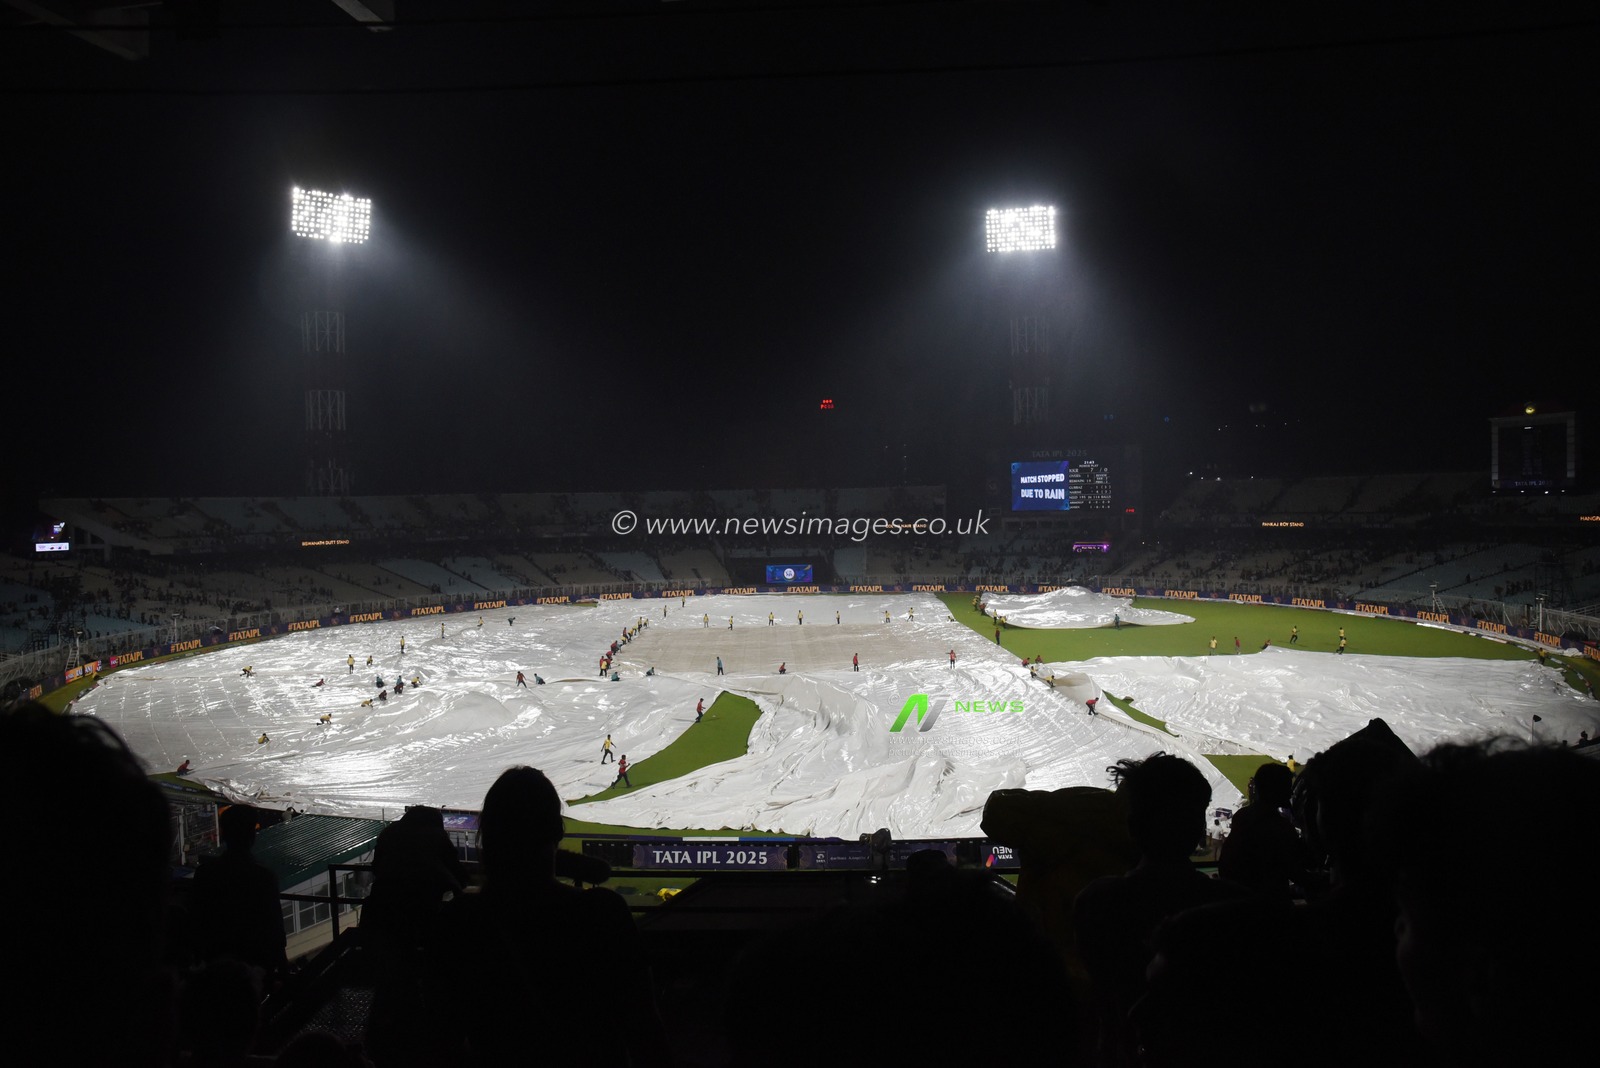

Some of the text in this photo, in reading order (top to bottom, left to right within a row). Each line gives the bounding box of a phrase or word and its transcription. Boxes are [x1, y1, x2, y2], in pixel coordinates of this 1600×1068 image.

[1020, 473, 1065, 484] MATCH STOPPED
[1020, 488, 1065, 500] DUE TO RAIN
[662, 589, 695, 598] #TATAIPL
[912, 584, 946, 592] #TATAIPL
[976, 584, 1010, 592] #TATAIPL
[1165, 589, 1200, 598] #TATAIPL
[537, 596, 571, 604] #TATAIPL
[600, 592, 633, 600] #TATAIPL
[1229, 593, 1264, 604] #TATAIPL
[474, 600, 508, 610] #TATAIPL
[1292, 598, 1326, 608] #TATAIPL
[1355, 602, 1390, 615] #TATAIPL
[412, 605, 446, 616] #TATAIPL
[350, 612, 384, 623] #TATAIPL
[1417, 610, 1450, 623] #TATAIPL
[288, 619, 321, 631] #TATAIPL
[1477, 619, 1508, 635] #TATAIPL
[229, 628, 262, 642] #TATAIPL
[1534, 631, 1561, 647] #TATAIPL
[170, 639, 203, 654] #TATAIPL
[992, 846, 1012, 854] NEU
[652, 850, 768, 864] TATA IPL 2025
